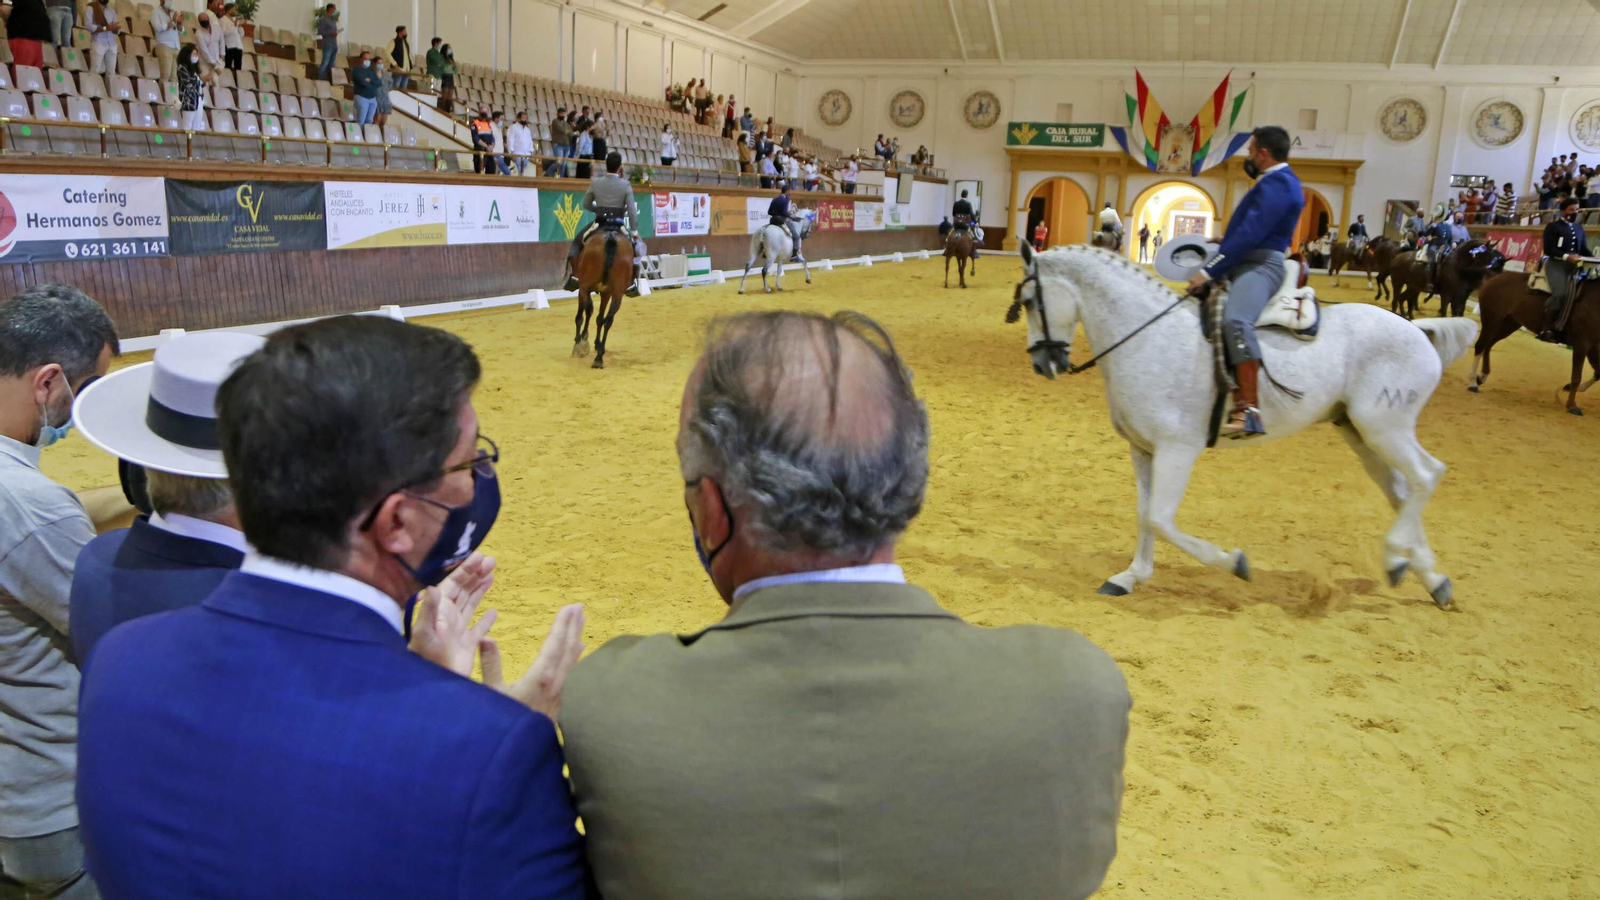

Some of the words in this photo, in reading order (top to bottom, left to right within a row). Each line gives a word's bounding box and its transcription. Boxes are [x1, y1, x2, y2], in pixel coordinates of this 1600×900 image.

[1046, 127, 1067, 135] CAJA
[1069, 127, 1098, 136] RURAL
[62, 187, 127, 207] Catering
[329, 190, 353, 198] HOTELES
[330, 199, 364, 207] ANDALUCES
[379, 200, 409, 213] JEREZ
[273, 212, 323, 222] www.casavidal.es
[330, 208, 345, 216] CON
[346, 208, 374, 216] ENCANTO
[26, 212, 109, 228] Hermanos
[113, 211, 162, 228] Gomez
[171, 213, 229, 224] www.casavidal.es
[234, 225, 251, 233] CASA
[251, 224, 270, 232] VIDAL
[401, 230, 444, 240] www.hace.es
[81, 243, 107, 257] 621
[113, 242, 137, 255] 361
[143, 241, 166, 254] 141
